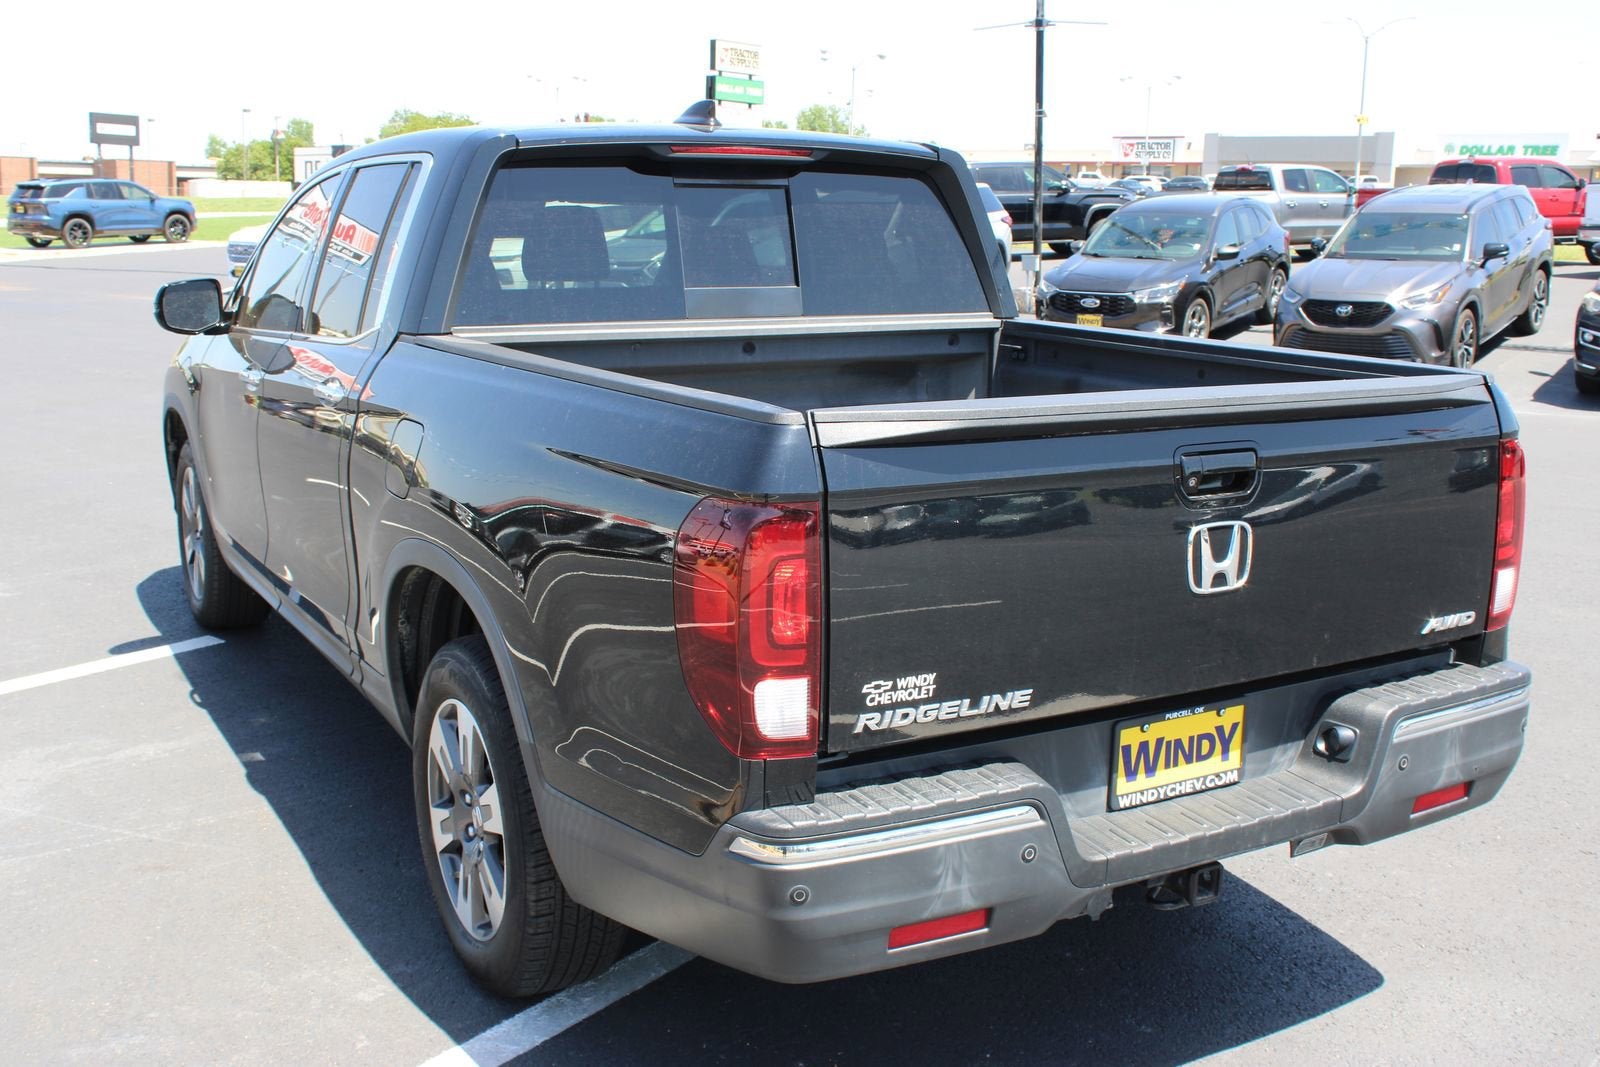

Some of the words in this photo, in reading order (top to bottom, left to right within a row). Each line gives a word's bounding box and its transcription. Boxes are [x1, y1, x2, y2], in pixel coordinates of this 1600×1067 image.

[730, 47, 760, 60] TRACTOR
[729, 57, 752, 68] SUPPLY
[1135, 141, 1172, 151] TRACTOR
[1459, 145, 1515, 156] DOLLAR
[1522, 145, 1559, 156] TREE
[1135, 150, 1161, 159] SUPPLY
[1421, 610, 1477, 635] AWD
[896, 672, 937, 690] WINDY
[866, 685, 936, 707] CHEVROLET
[852, 689, 1034, 734] RIDGELINE
[1165, 709, 1193, 720] PURCELL,
[1194, 706, 1205, 714] OK
[1121, 721, 1241, 783] WINDY
[1118, 769, 1239, 809] WINDYCHEV.COM
